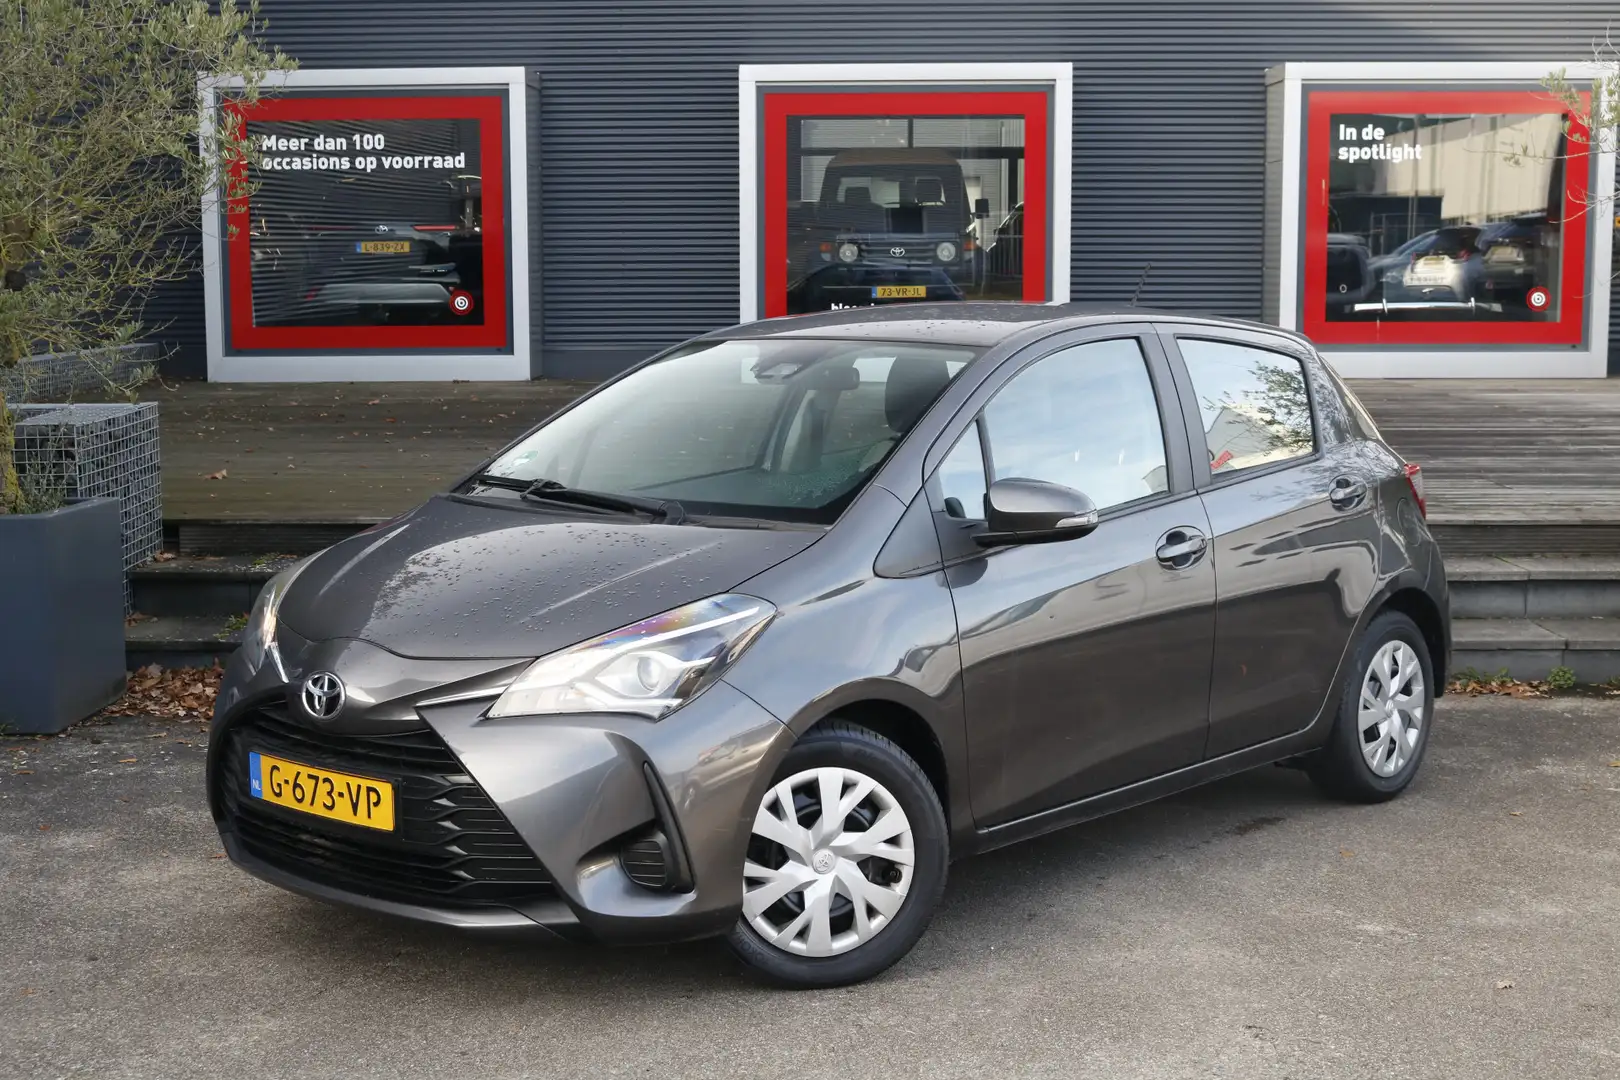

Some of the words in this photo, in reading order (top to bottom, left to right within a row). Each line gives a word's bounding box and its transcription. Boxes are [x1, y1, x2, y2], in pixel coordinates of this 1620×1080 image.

[1339, 123, 1357, 141] In
[1361, 123, 1385, 141] de
[262, 134, 309, 151] Meer
[313, 134, 347, 151] dan
[352, 133, 385, 150] 100
[262, 153, 350, 170] occasions
[355, 156, 377, 173] op
[381, 152, 465, 169] voorraad
[1338, 143, 1422, 164] spotlight
[881, 287, 921, 297] 73-VR-JL
[252, 778, 262, 791] NL
[269, 764, 381, 819] G-673-VP
